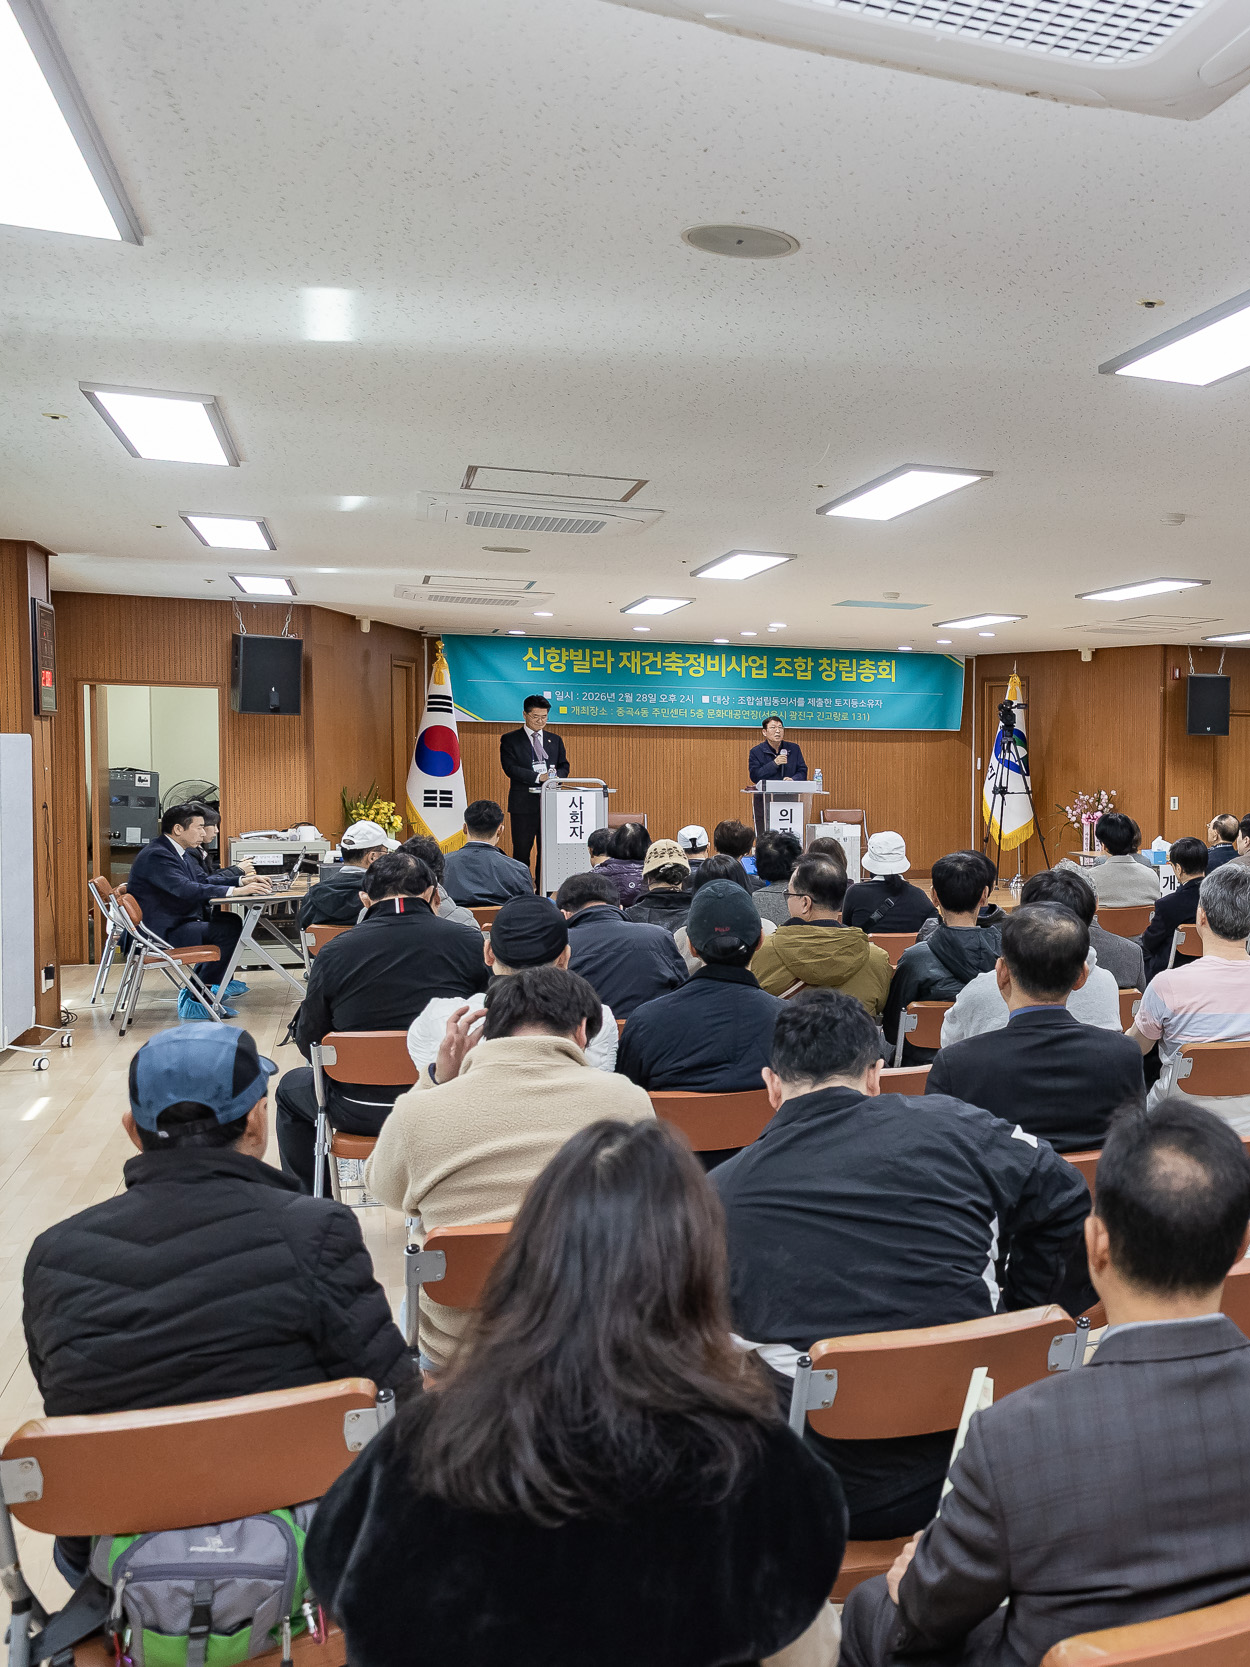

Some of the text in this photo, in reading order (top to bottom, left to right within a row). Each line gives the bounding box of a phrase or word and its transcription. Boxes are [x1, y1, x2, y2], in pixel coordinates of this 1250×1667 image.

[522, 647, 896, 683] 신향빌라 재건축정비사업 조합 창립총회
[554, 691, 574, 701] 일시
[582, 692, 615, 702] 2026년
[618, 692, 633, 703] 2월
[636, 693, 657, 703] 28일
[659, 693, 677, 704] 오후
[679, 694, 694, 704] 2시
[712, 695, 730, 705] 대상
[737, 696, 805, 708] 조합설립동의서를
[807, 698, 832, 708] 제출한
[834, 698, 883, 709] 토지등소유자
[571, 706, 608, 717] 개최장소
[616, 707, 649, 718] 중곡4동
[652, 707, 688, 718] 주민센터
[690, 708, 704, 718] 5층
[789, 711, 814, 721] 광진구
[852, 712, 870, 722] 131)
[569, 796, 584, 839] 사회자
